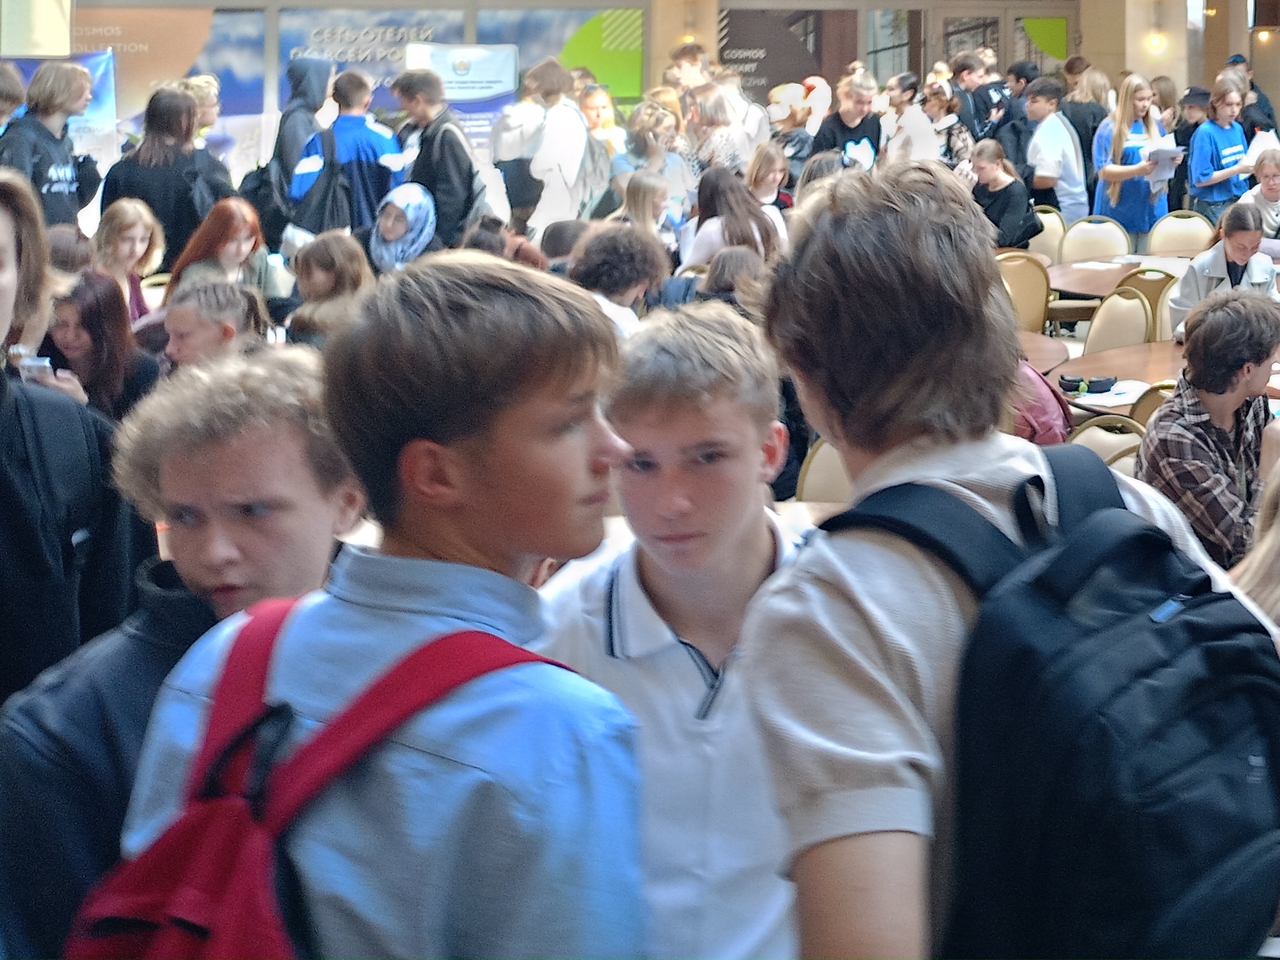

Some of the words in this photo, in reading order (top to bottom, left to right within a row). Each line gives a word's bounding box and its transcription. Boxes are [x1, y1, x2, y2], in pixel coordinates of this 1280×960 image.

[73, 26, 122, 37] OSMOS
[313, 26, 358, 43] СЕТЬ
[361, 25, 435, 43] ОТЕЛЕЙ
[74, 42, 149, 54] OLLECTION
[724, 49, 767, 59] COSMOS
